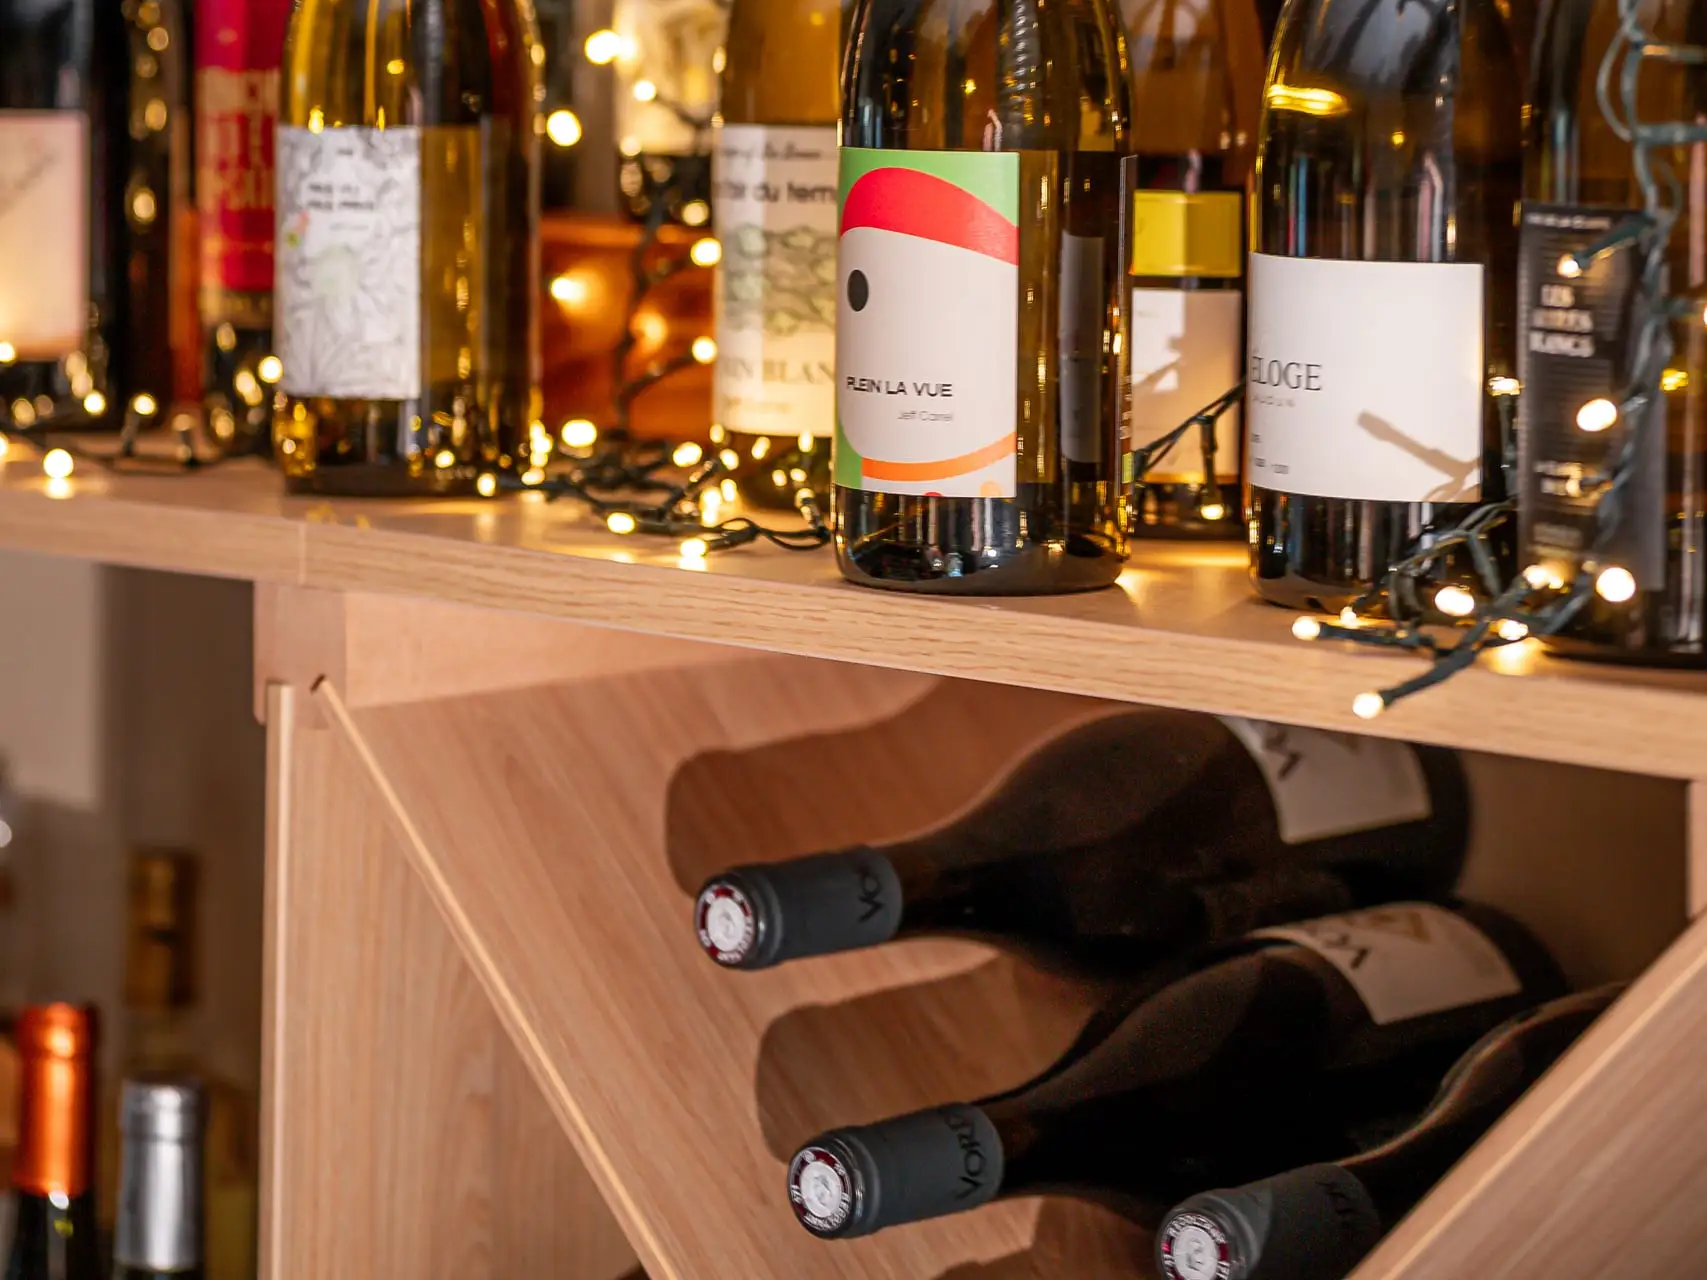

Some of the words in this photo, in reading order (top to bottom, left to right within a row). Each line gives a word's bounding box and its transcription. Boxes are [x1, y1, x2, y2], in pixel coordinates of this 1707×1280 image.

[846, 375, 882, 393] PLEIN
[885, 380, 908, 396] LA
[912, 382, 954, 398] VUE
